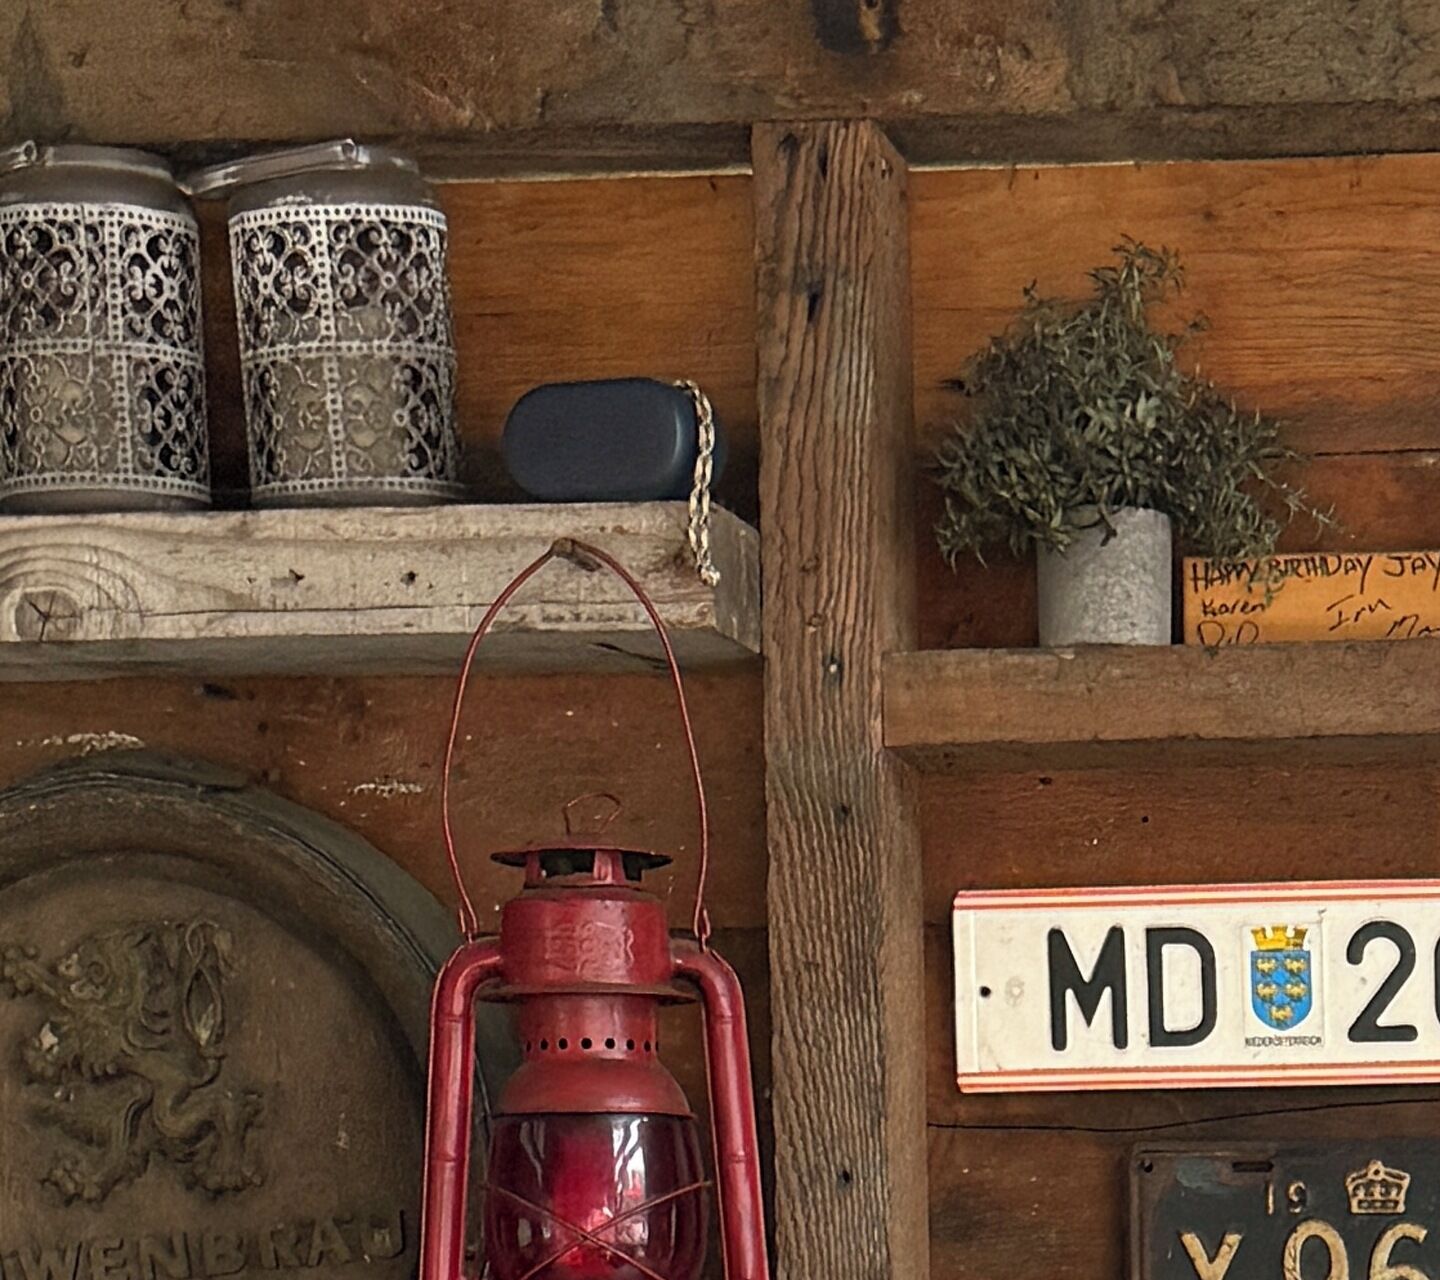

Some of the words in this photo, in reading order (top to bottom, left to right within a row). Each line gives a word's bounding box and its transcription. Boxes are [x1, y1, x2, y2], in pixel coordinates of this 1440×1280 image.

[1192, 561, 1258, 594] HAPPY
[1268, 554, 1373, 594] BIRTHDAY
[1202, 599, 1265, 617] Karen
[1047, 924, 1218, 1051] MD
[1264, 1179, 1309, 1215] 19
